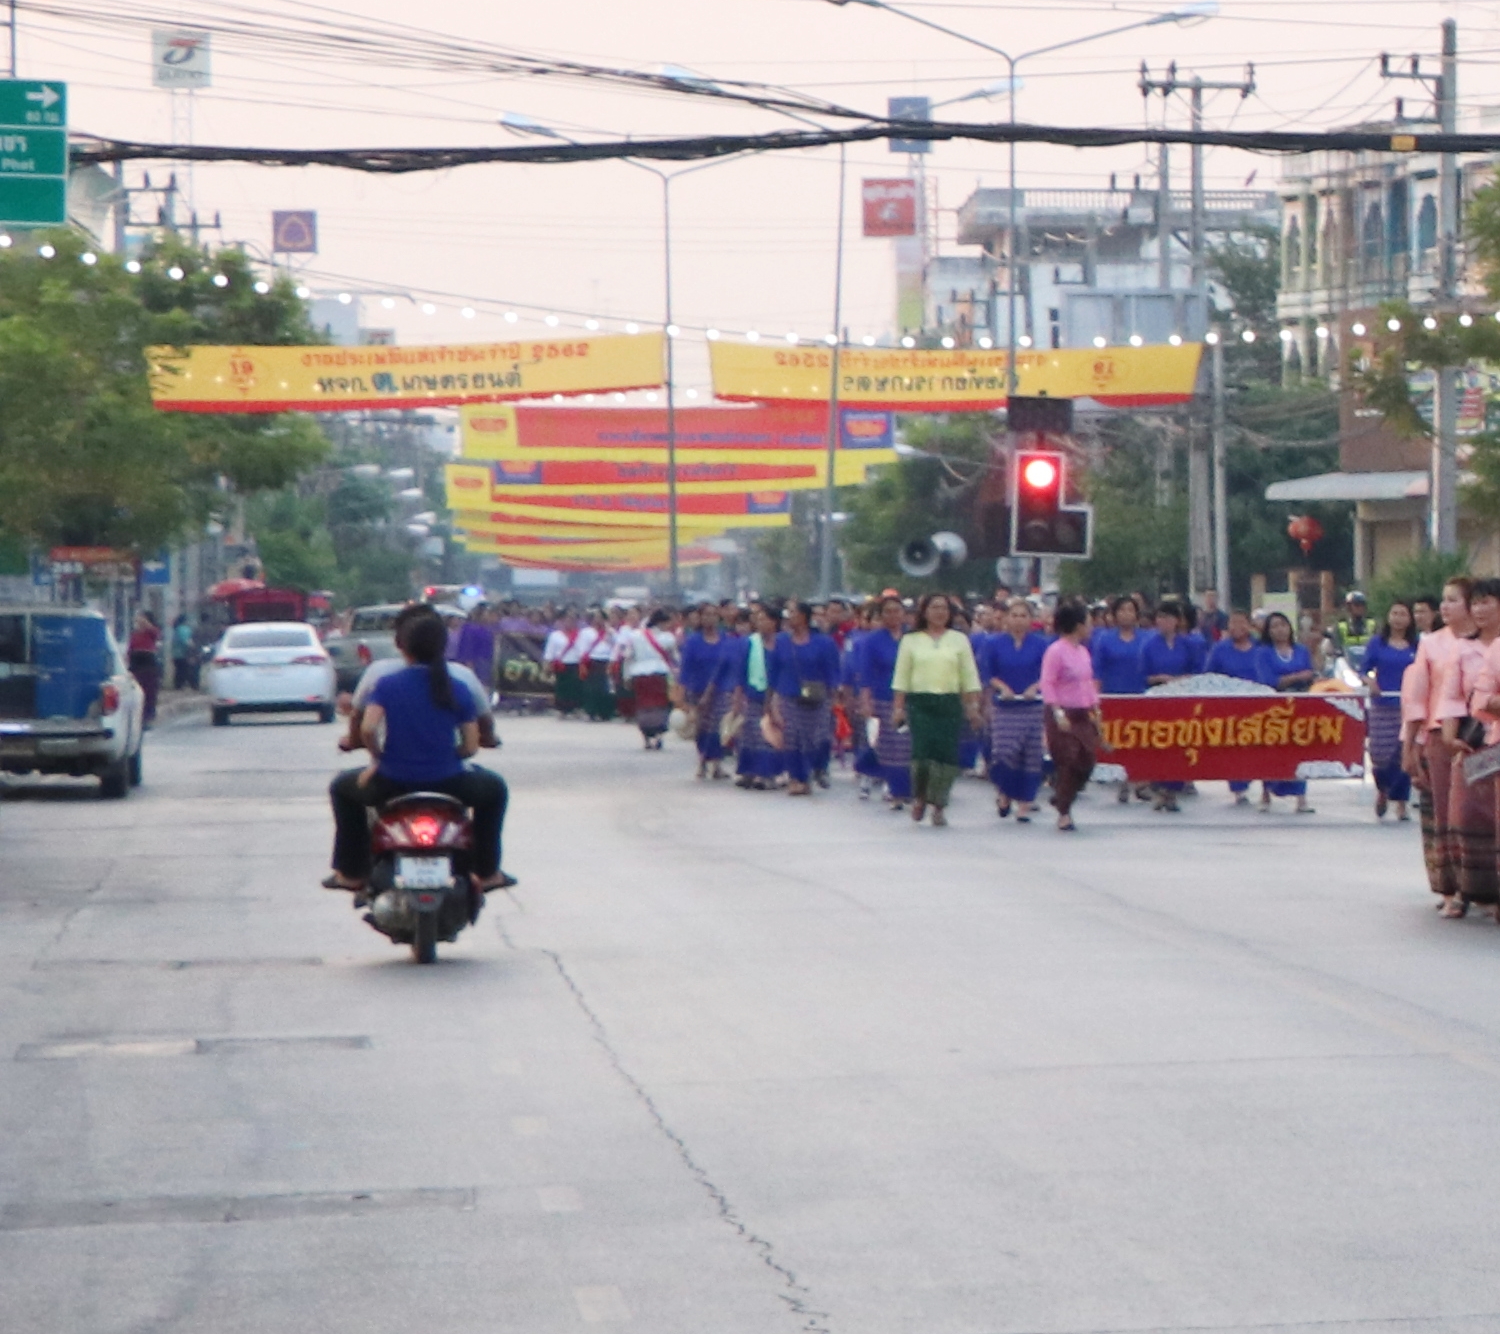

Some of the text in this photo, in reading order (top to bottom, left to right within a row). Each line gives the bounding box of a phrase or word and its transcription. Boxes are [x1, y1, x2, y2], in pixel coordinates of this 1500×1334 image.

[532, 342, 590, 361] 2562
[1100, 698, 1345, 766] เภอทุ่งเสลี่ยม
